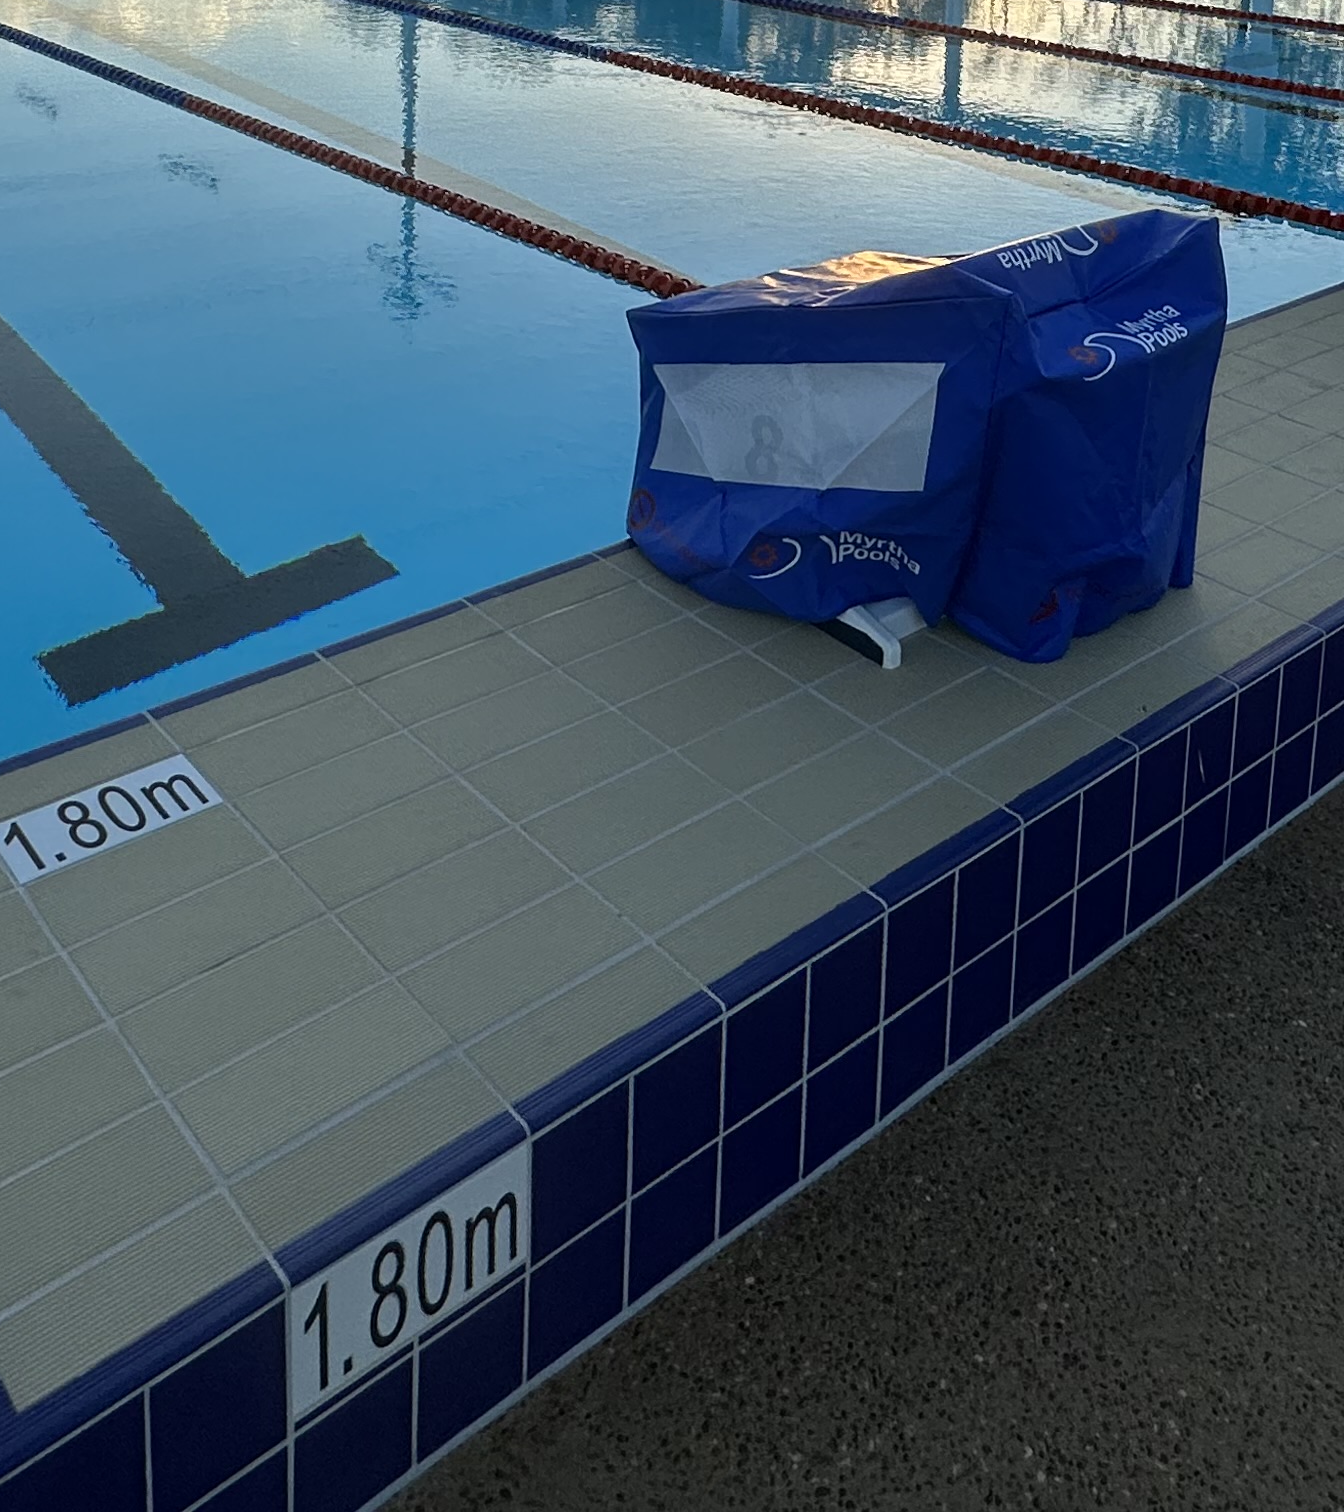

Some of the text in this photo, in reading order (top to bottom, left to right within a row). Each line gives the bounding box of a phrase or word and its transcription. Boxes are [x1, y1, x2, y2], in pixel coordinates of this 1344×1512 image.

[996, 237, 1063, 271] Myrtha
[1115, 304, 1182, 335] Myrtha
[1137, 322, 1189, 352] Pools
[745, 414, 783, 477] 8
[838, 544, 901, 571] Pools
[839, 531, 921, 576] Myrtha
[4, 773, 209, 870] 1.80m
[304, 1191, 518, 1391] 1.80m
